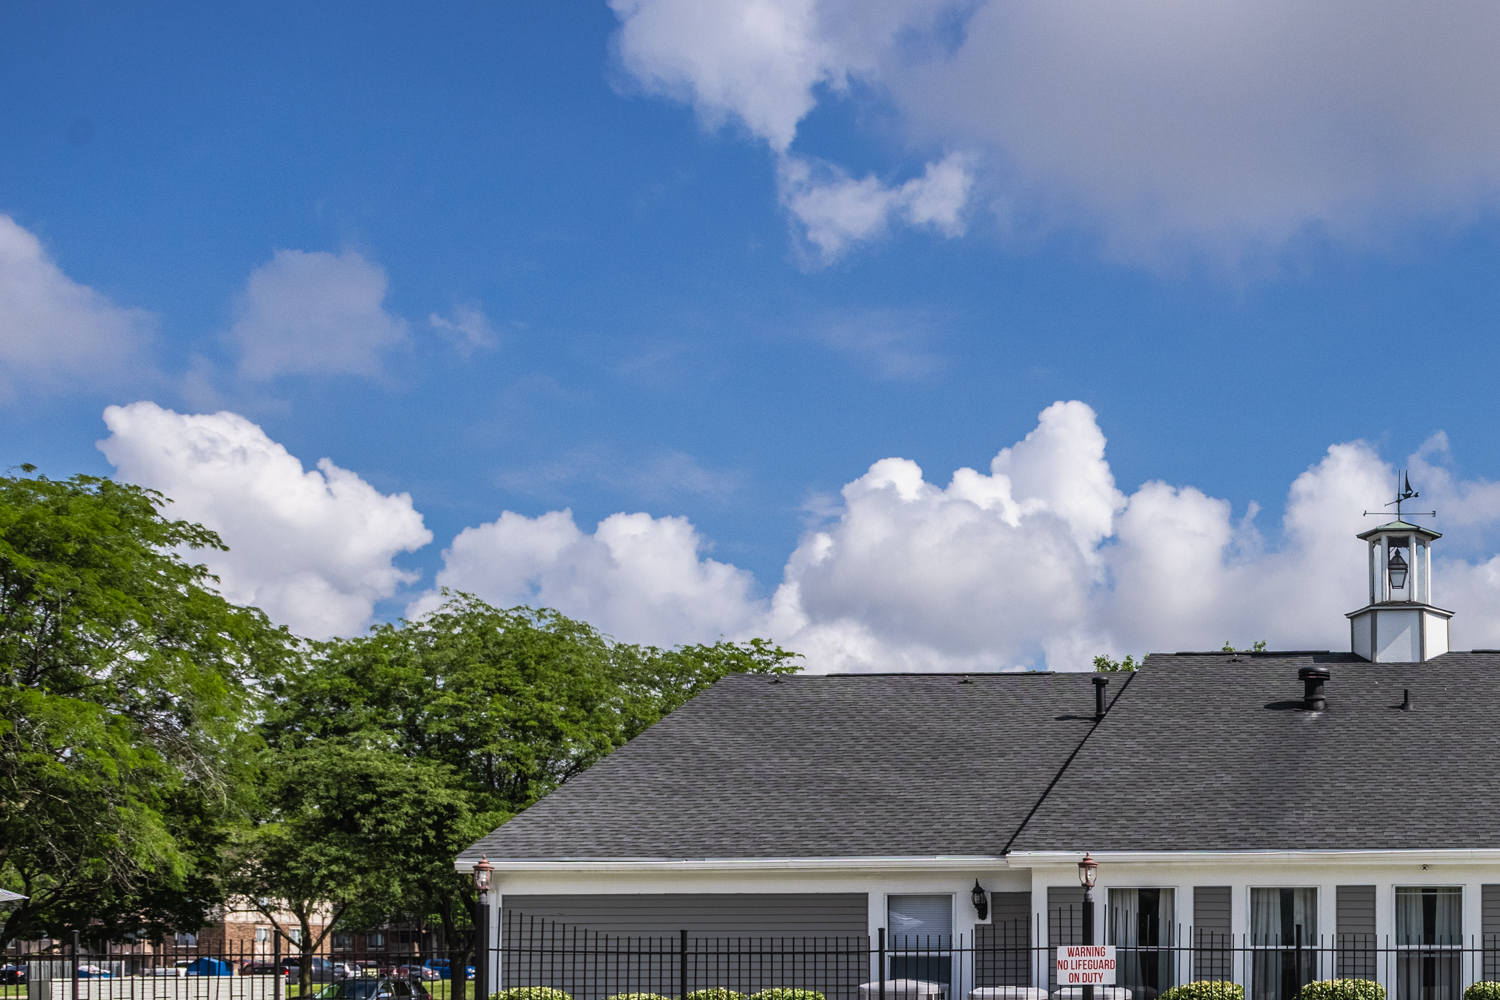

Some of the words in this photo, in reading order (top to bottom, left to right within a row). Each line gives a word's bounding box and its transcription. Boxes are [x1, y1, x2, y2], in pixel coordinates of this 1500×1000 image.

[1067, 946, 1106, 957] WARNING
[1057, 960, 1068, 970] NO
[1070, 959, 1115, 970] LIFEGUARD
[1068, 972, 1080, 983] ON
[1082, 972, 1104, 983] DUTY
